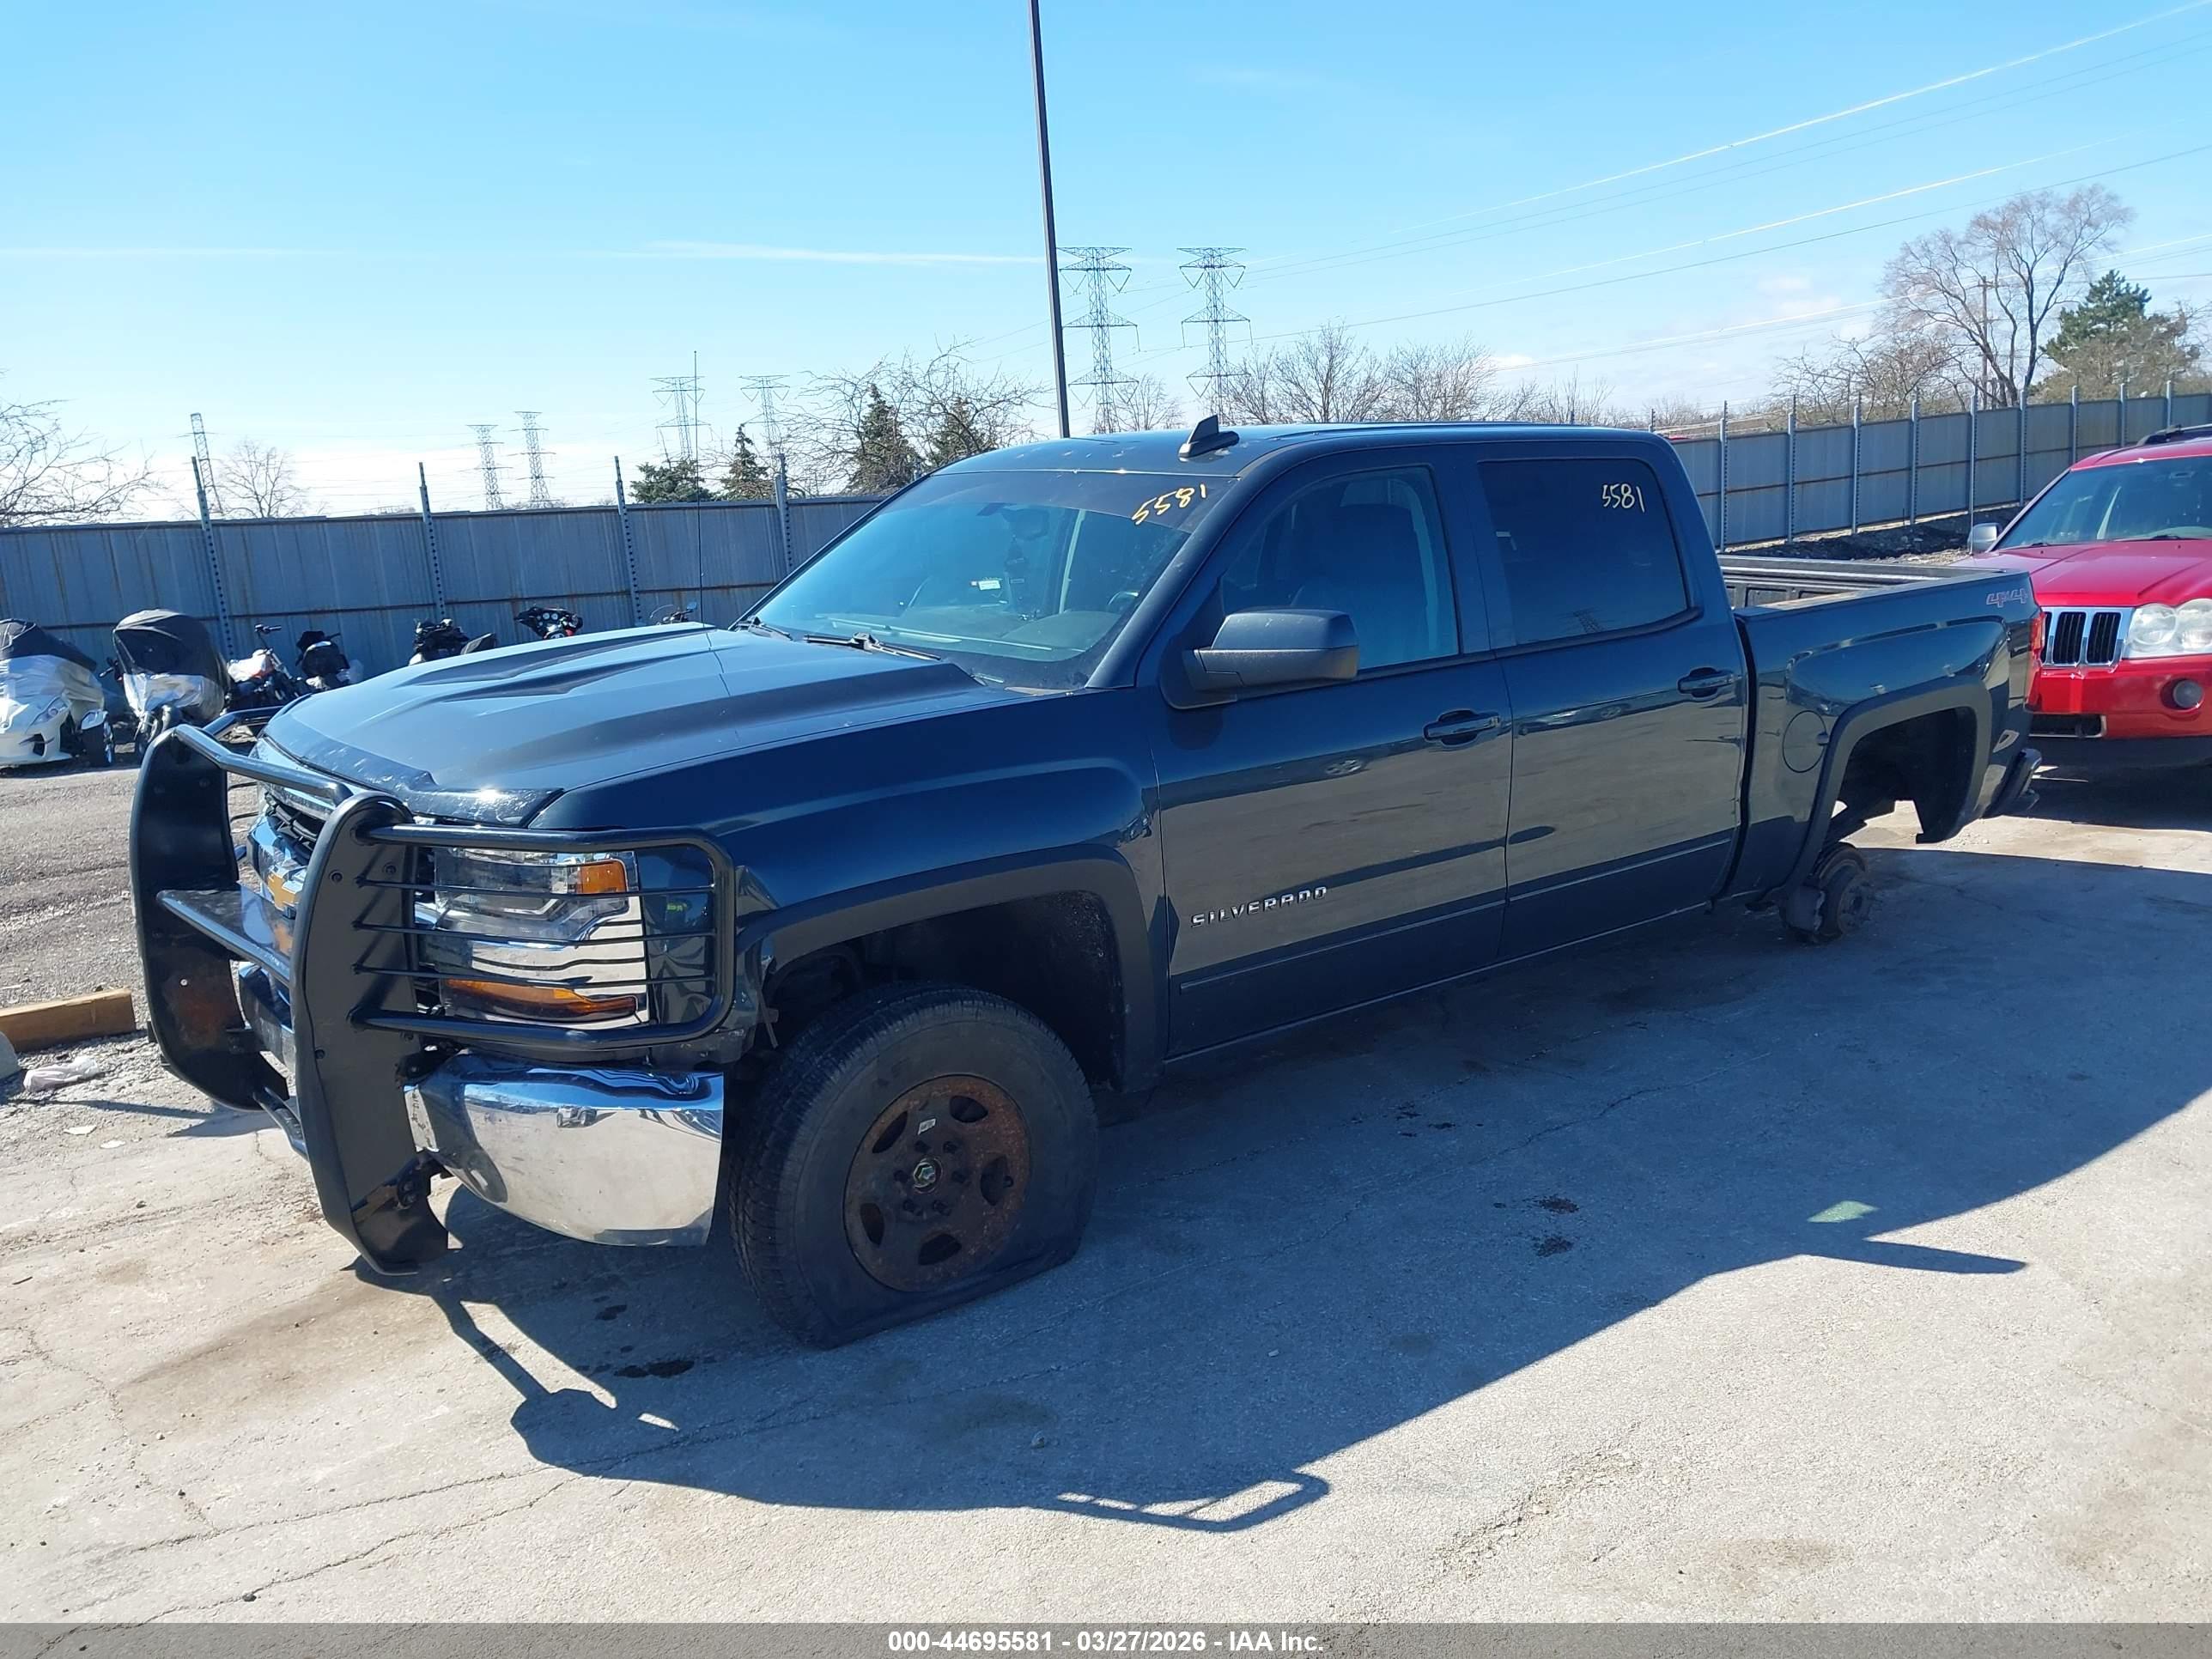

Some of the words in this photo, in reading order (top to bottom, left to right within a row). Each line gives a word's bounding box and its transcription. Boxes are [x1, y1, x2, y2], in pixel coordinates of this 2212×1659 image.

[1131, 483, 1206, 526] 5581
[1601, 483, 1645, 514] 5581
[1190, 886, 1328, 928] SILVERADO
